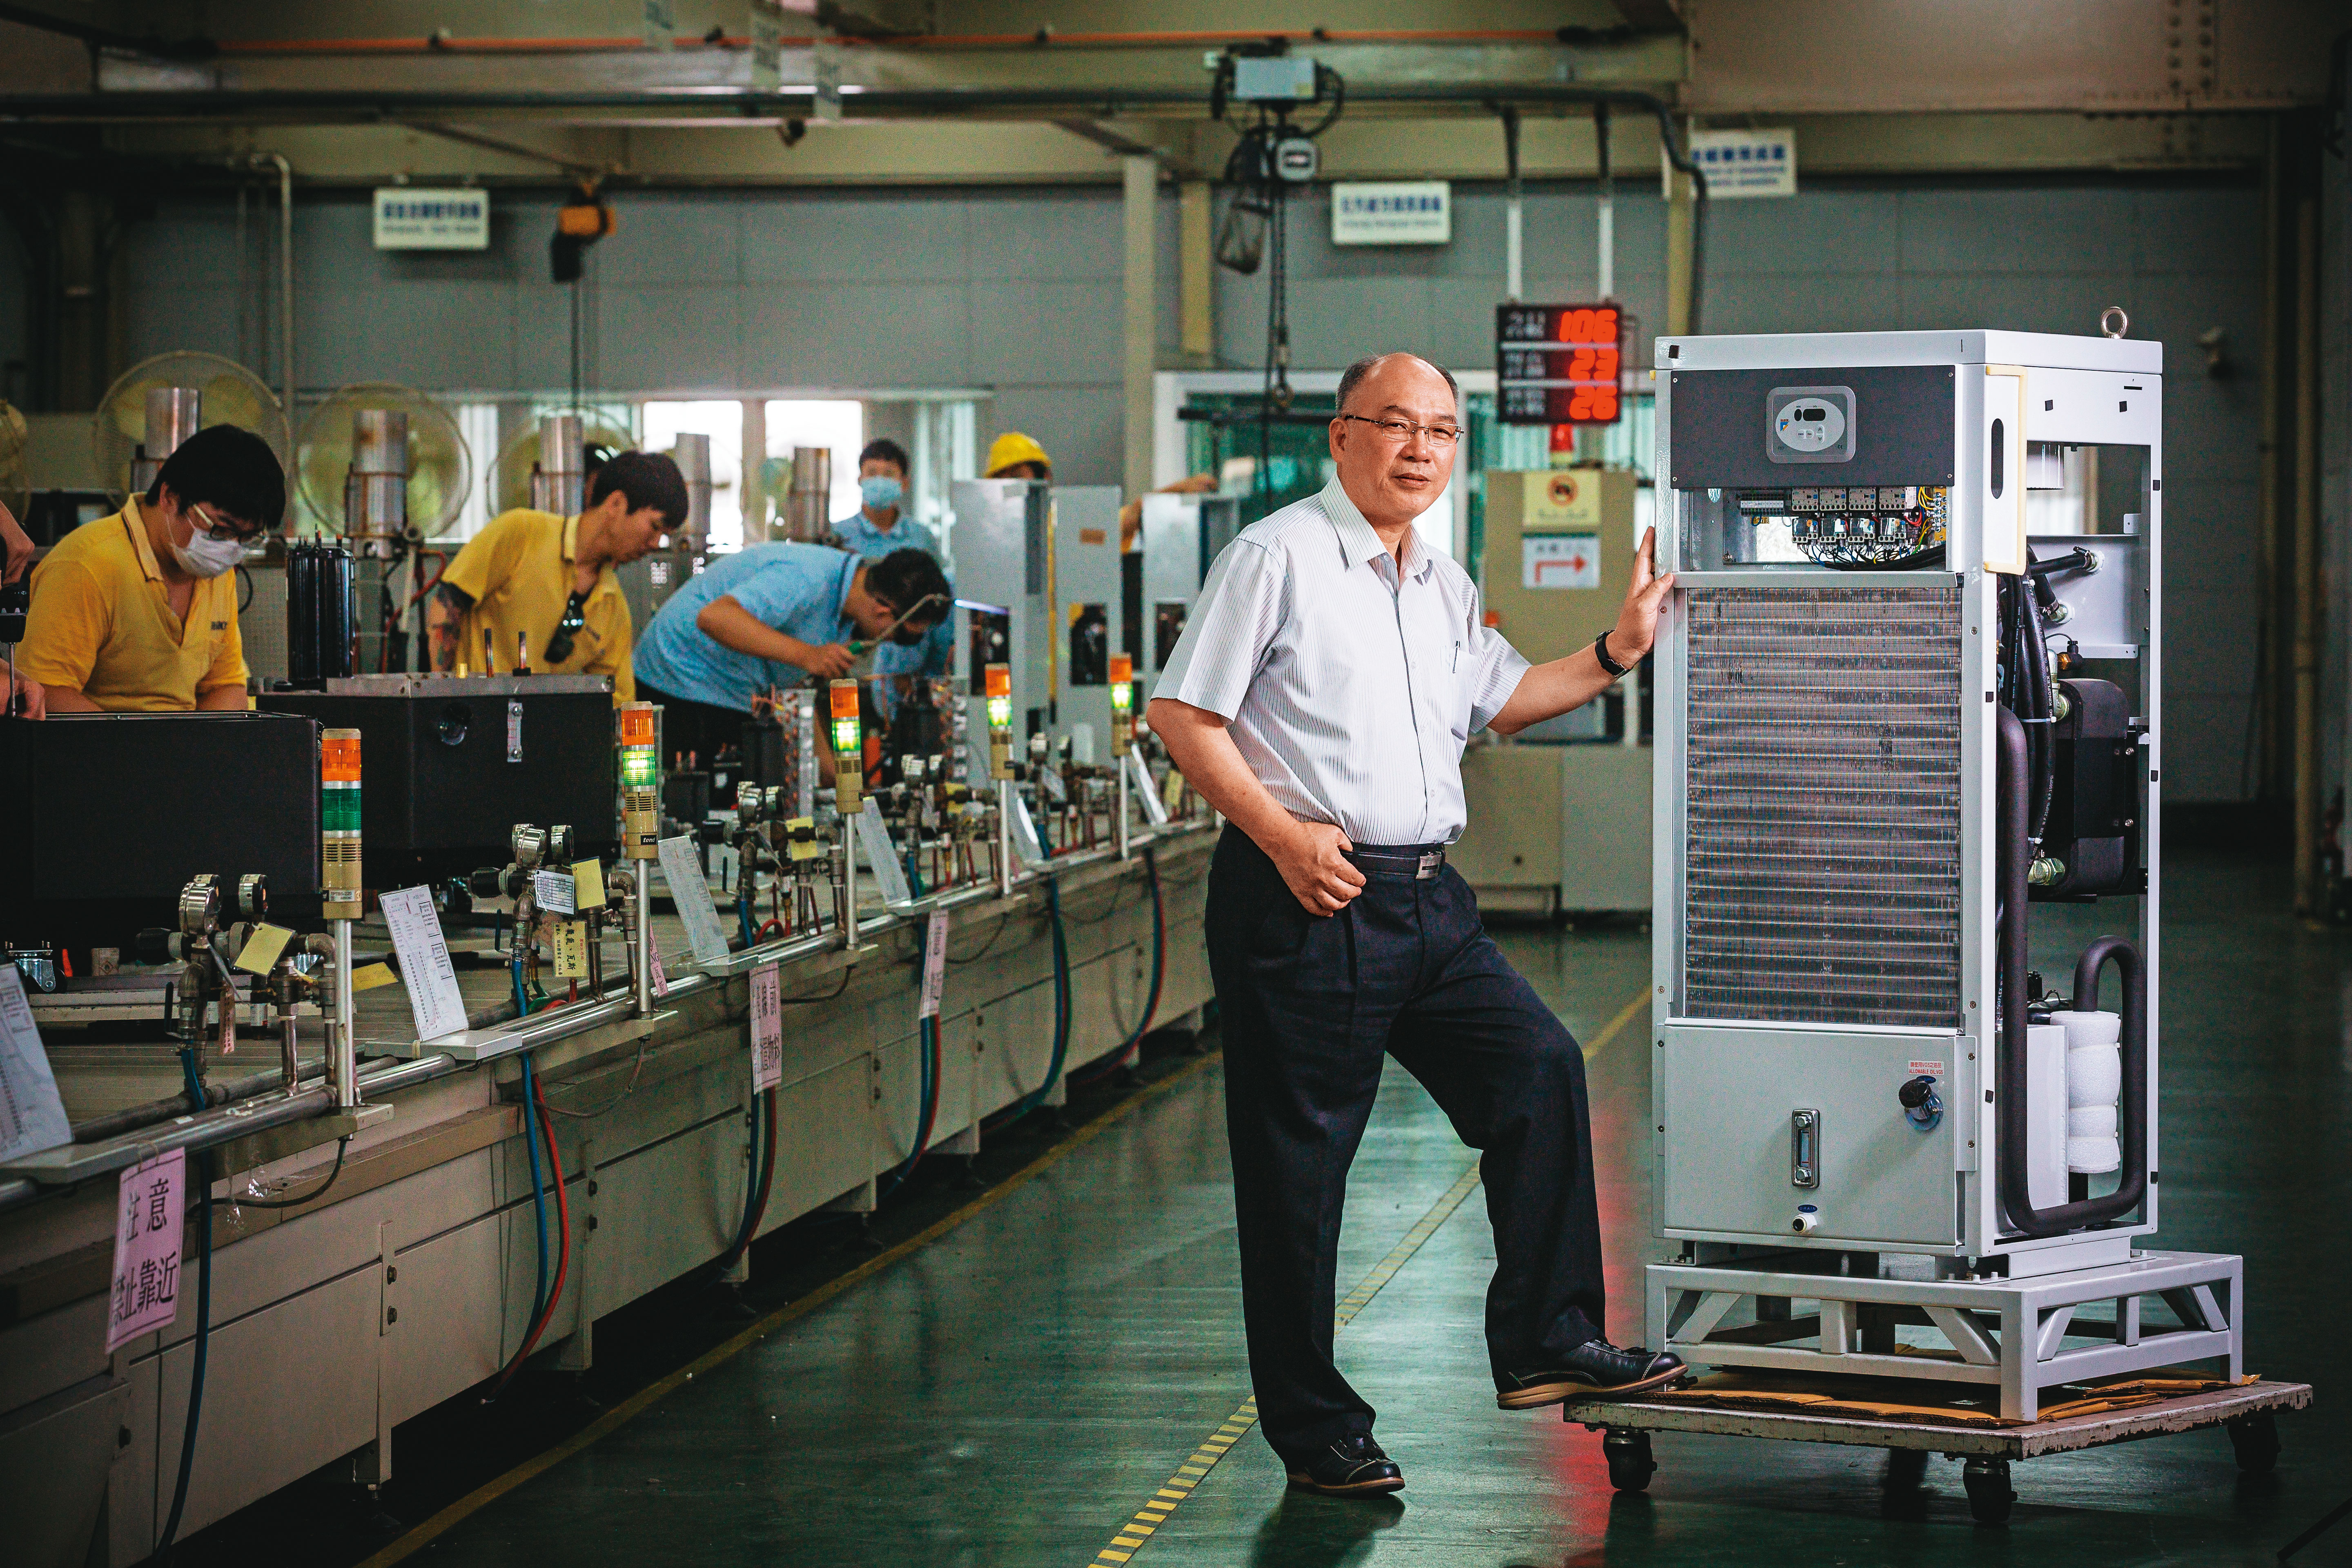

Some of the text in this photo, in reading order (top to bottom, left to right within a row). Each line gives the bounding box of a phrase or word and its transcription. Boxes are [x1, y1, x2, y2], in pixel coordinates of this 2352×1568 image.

[1559, 310, 1617, 344] 106
[1569, 348, 1618, 381] 23
[1570, 385, 1617, 420] 26
